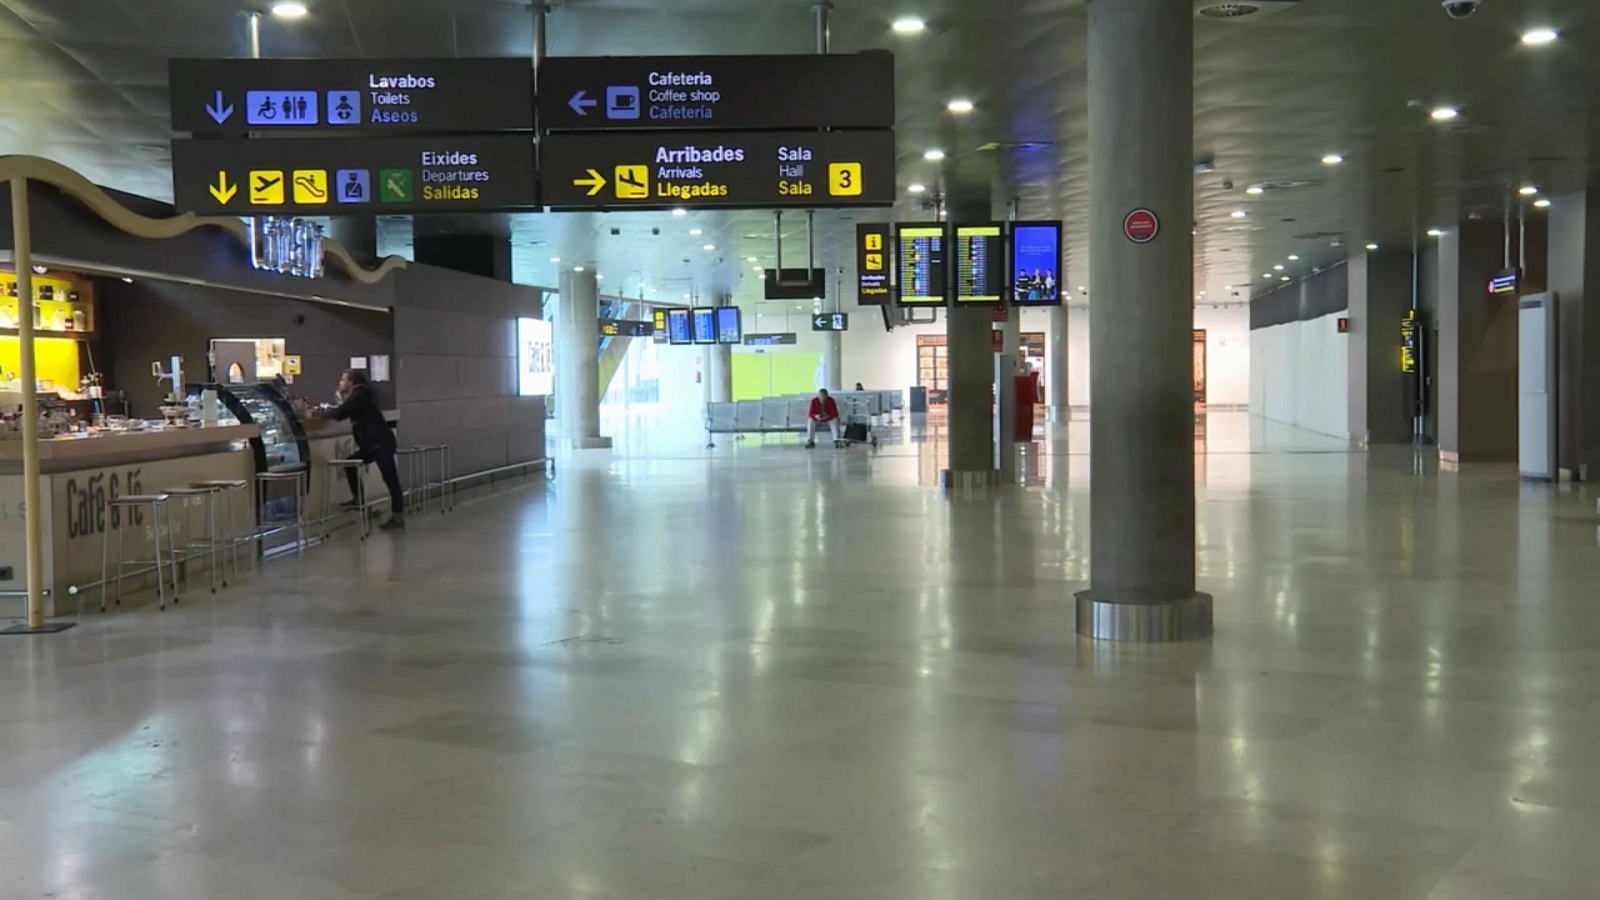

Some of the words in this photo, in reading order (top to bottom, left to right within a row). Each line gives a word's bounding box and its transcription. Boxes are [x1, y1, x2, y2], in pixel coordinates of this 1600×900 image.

[369, 74, 436, 88] Lavabos
[649, 71, 713, 86] Cafeteria
[370, 92, 411, 105] Toilets
[649, 89, 687, 102] Coffee
[690, 90, 720, 104] shop
[370, 108, 419, 123] Aseos
[649, 104, 713, 120] Cafetería
[421, 151, 478, 166] Eixides
[655, 146, 745, 163] Arribades
[778, 146, 812, 161] Sala
[421, 169, 490, 183] Departures
[657, 166, 704, 179] Arrivals
[779, 164, 804, 177] Hall
[839, 169, 852, 189] 3
[422, 184, 480, 200] Salidas
[657, 182, 728, 199] Llegadas
[779, 180, 813, 195] Sala
